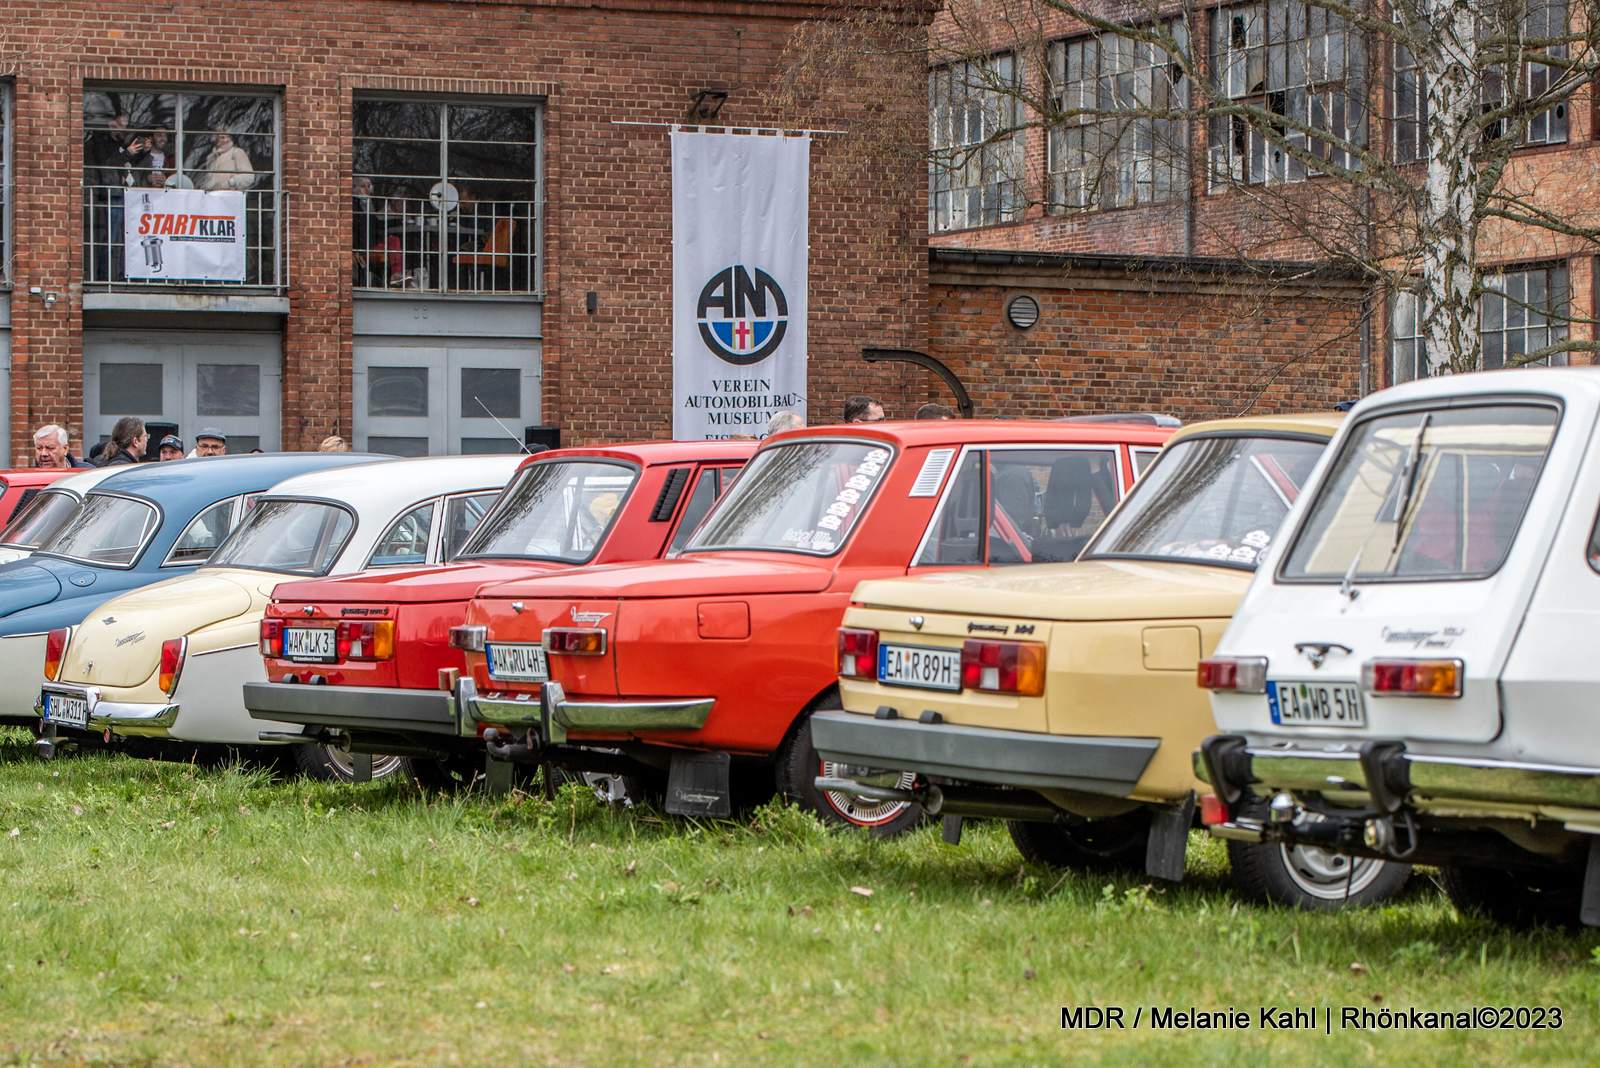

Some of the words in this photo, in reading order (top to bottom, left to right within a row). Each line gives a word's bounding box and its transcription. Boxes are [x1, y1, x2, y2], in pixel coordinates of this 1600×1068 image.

[711, 379, 771, 393] VEREIN
[288, 631, 305, 653] WAK
[309, 632, 321, 654] LK
[322, 632, 330, 654] 3
[887, 650, 903, 679] EA
[49, 696, 62, 718] SHL
[1280, 687, 1302, 719] EA
[1308, 687, 1332, 720] WB
